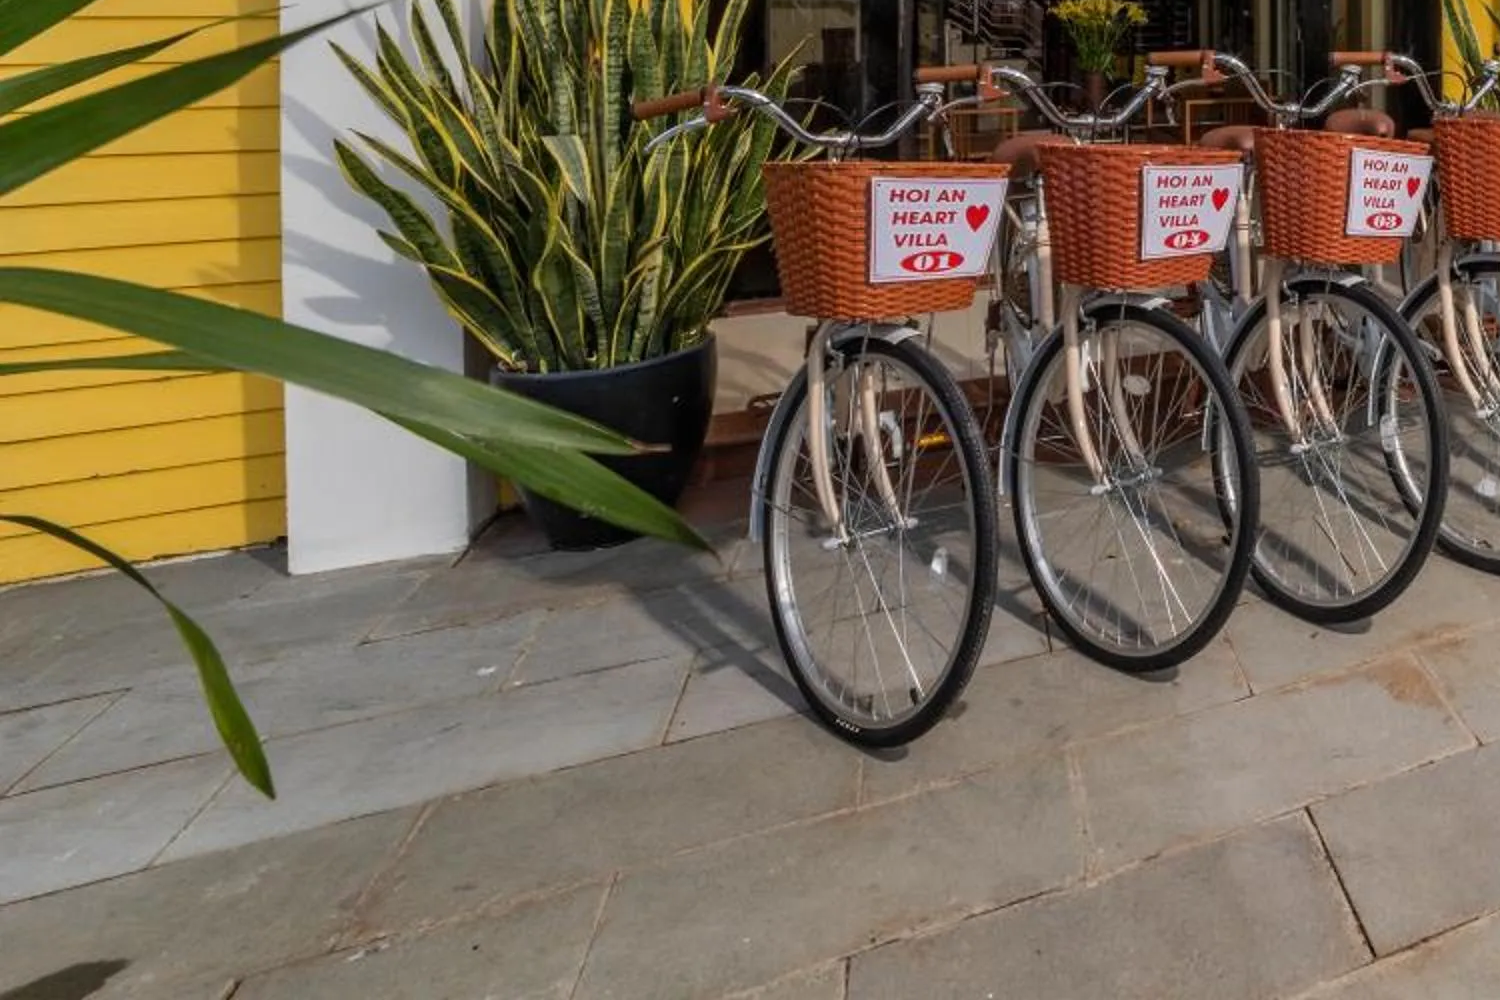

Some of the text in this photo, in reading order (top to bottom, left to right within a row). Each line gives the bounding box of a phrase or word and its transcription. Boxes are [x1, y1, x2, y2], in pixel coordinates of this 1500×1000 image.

[1363, 159, 1409, 174] HOI AN
[1157, 175, 1213, 188] HOI AN
[1363, 177, 1402, 190] HEART
[889, 189, 967, 203] HOI AN
[1158, 194, 1207, 208] HEART
[1363, 195, 1395, 208] VILLA
[891, 211, 959, 226] HEART
[1159, 214, 1199, 228] VILLA
[893, 234, 948, 248] VILLA
